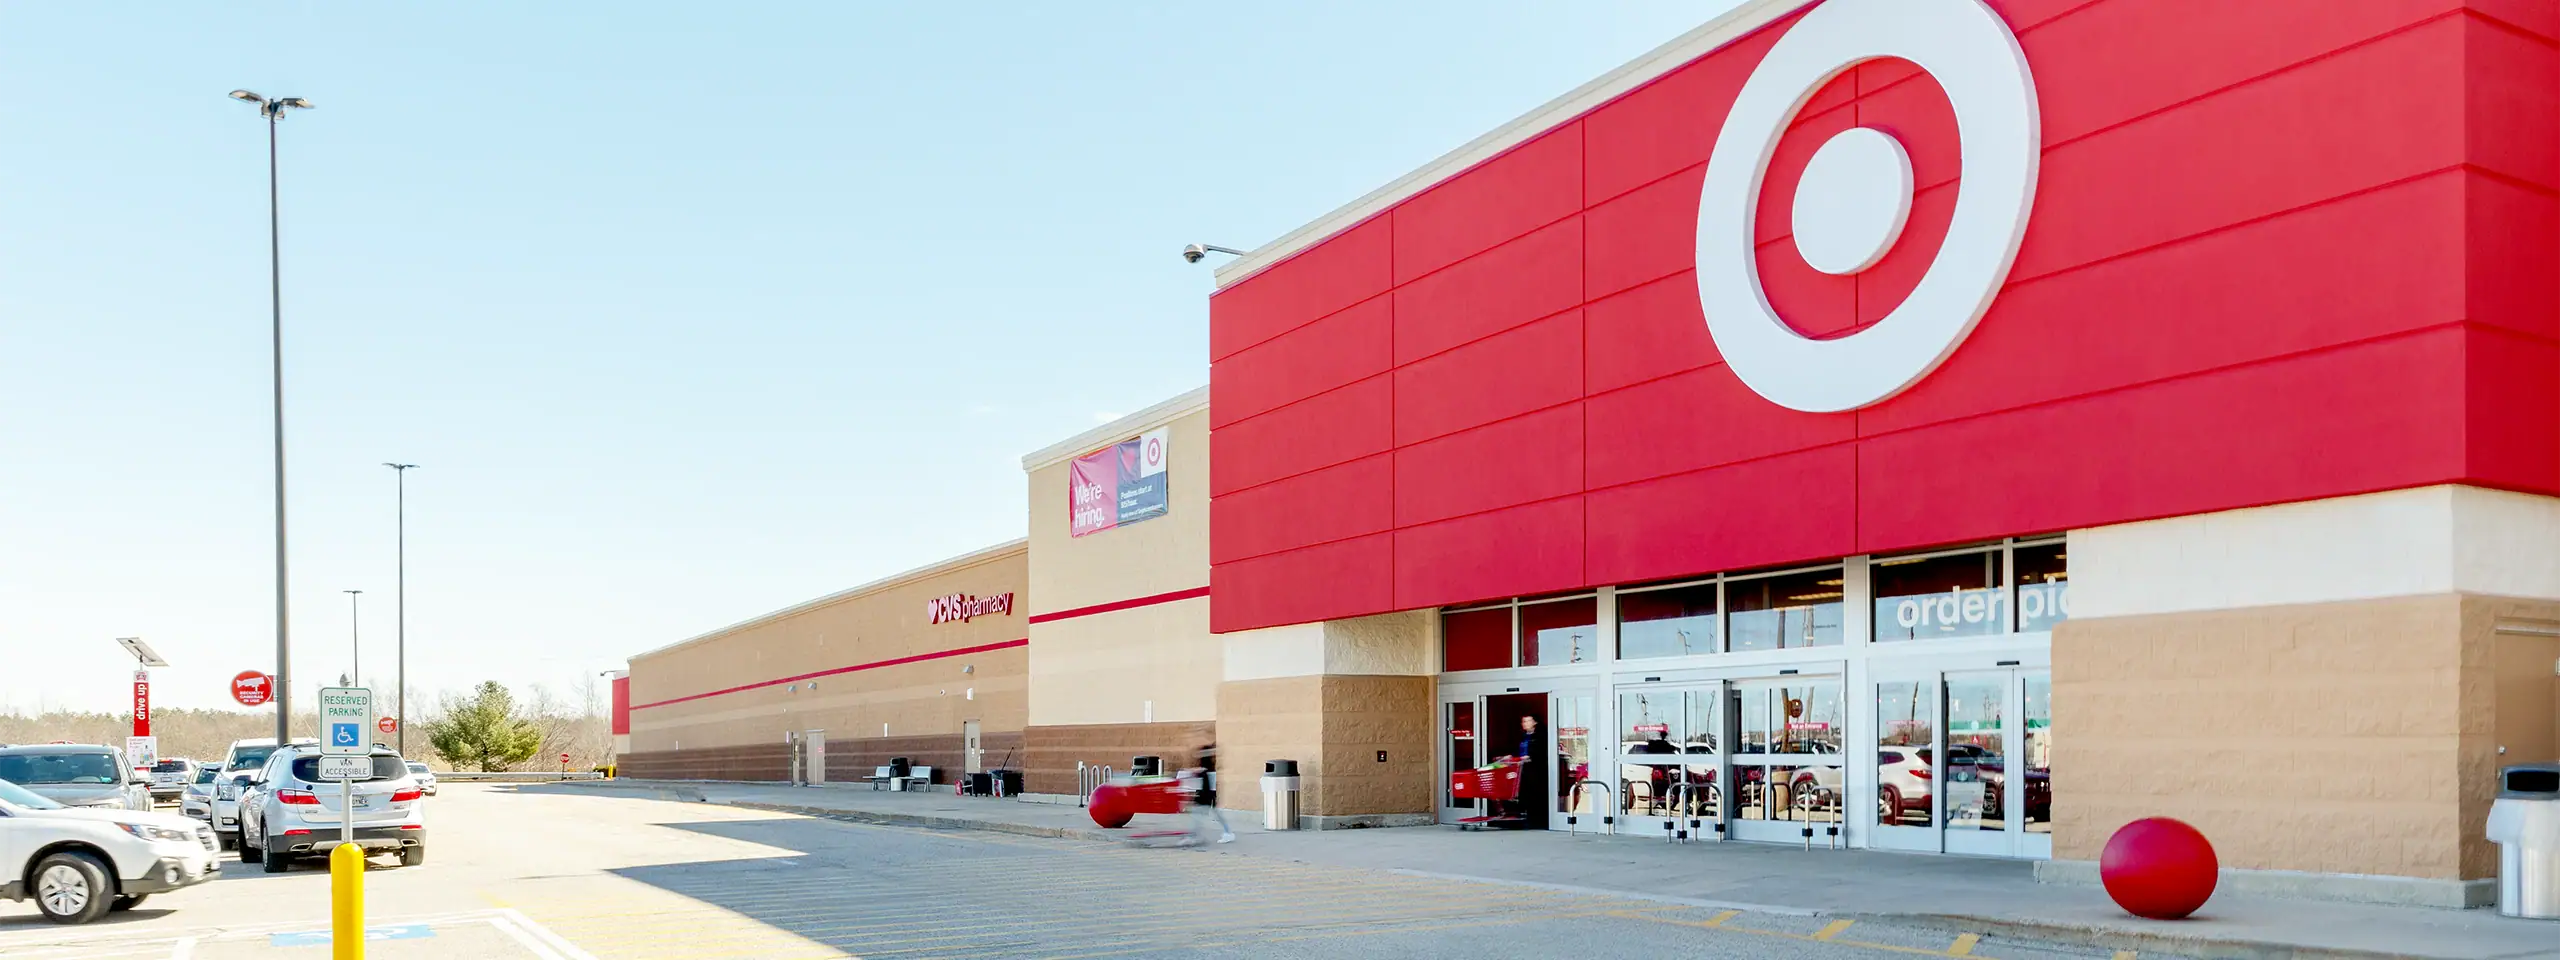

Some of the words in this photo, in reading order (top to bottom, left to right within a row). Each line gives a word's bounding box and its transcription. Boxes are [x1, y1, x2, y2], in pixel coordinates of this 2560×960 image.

[1075, 482, 1102, 505] We're
[1075, 506, 1104, 528] hiring.
[938, 593, 963, 623] CVS
[962, 592, 1012, 623] pharmacy
[1897, 585, 2004, 628] order
[138, 683, 147, 696] up
[136, 698, 146, 720] drive
[324, 696, 368, 706] RESERVED
[328, 707, 364, 717] PARKING
[325, 768, 368, 776] ACCESSIBLE
